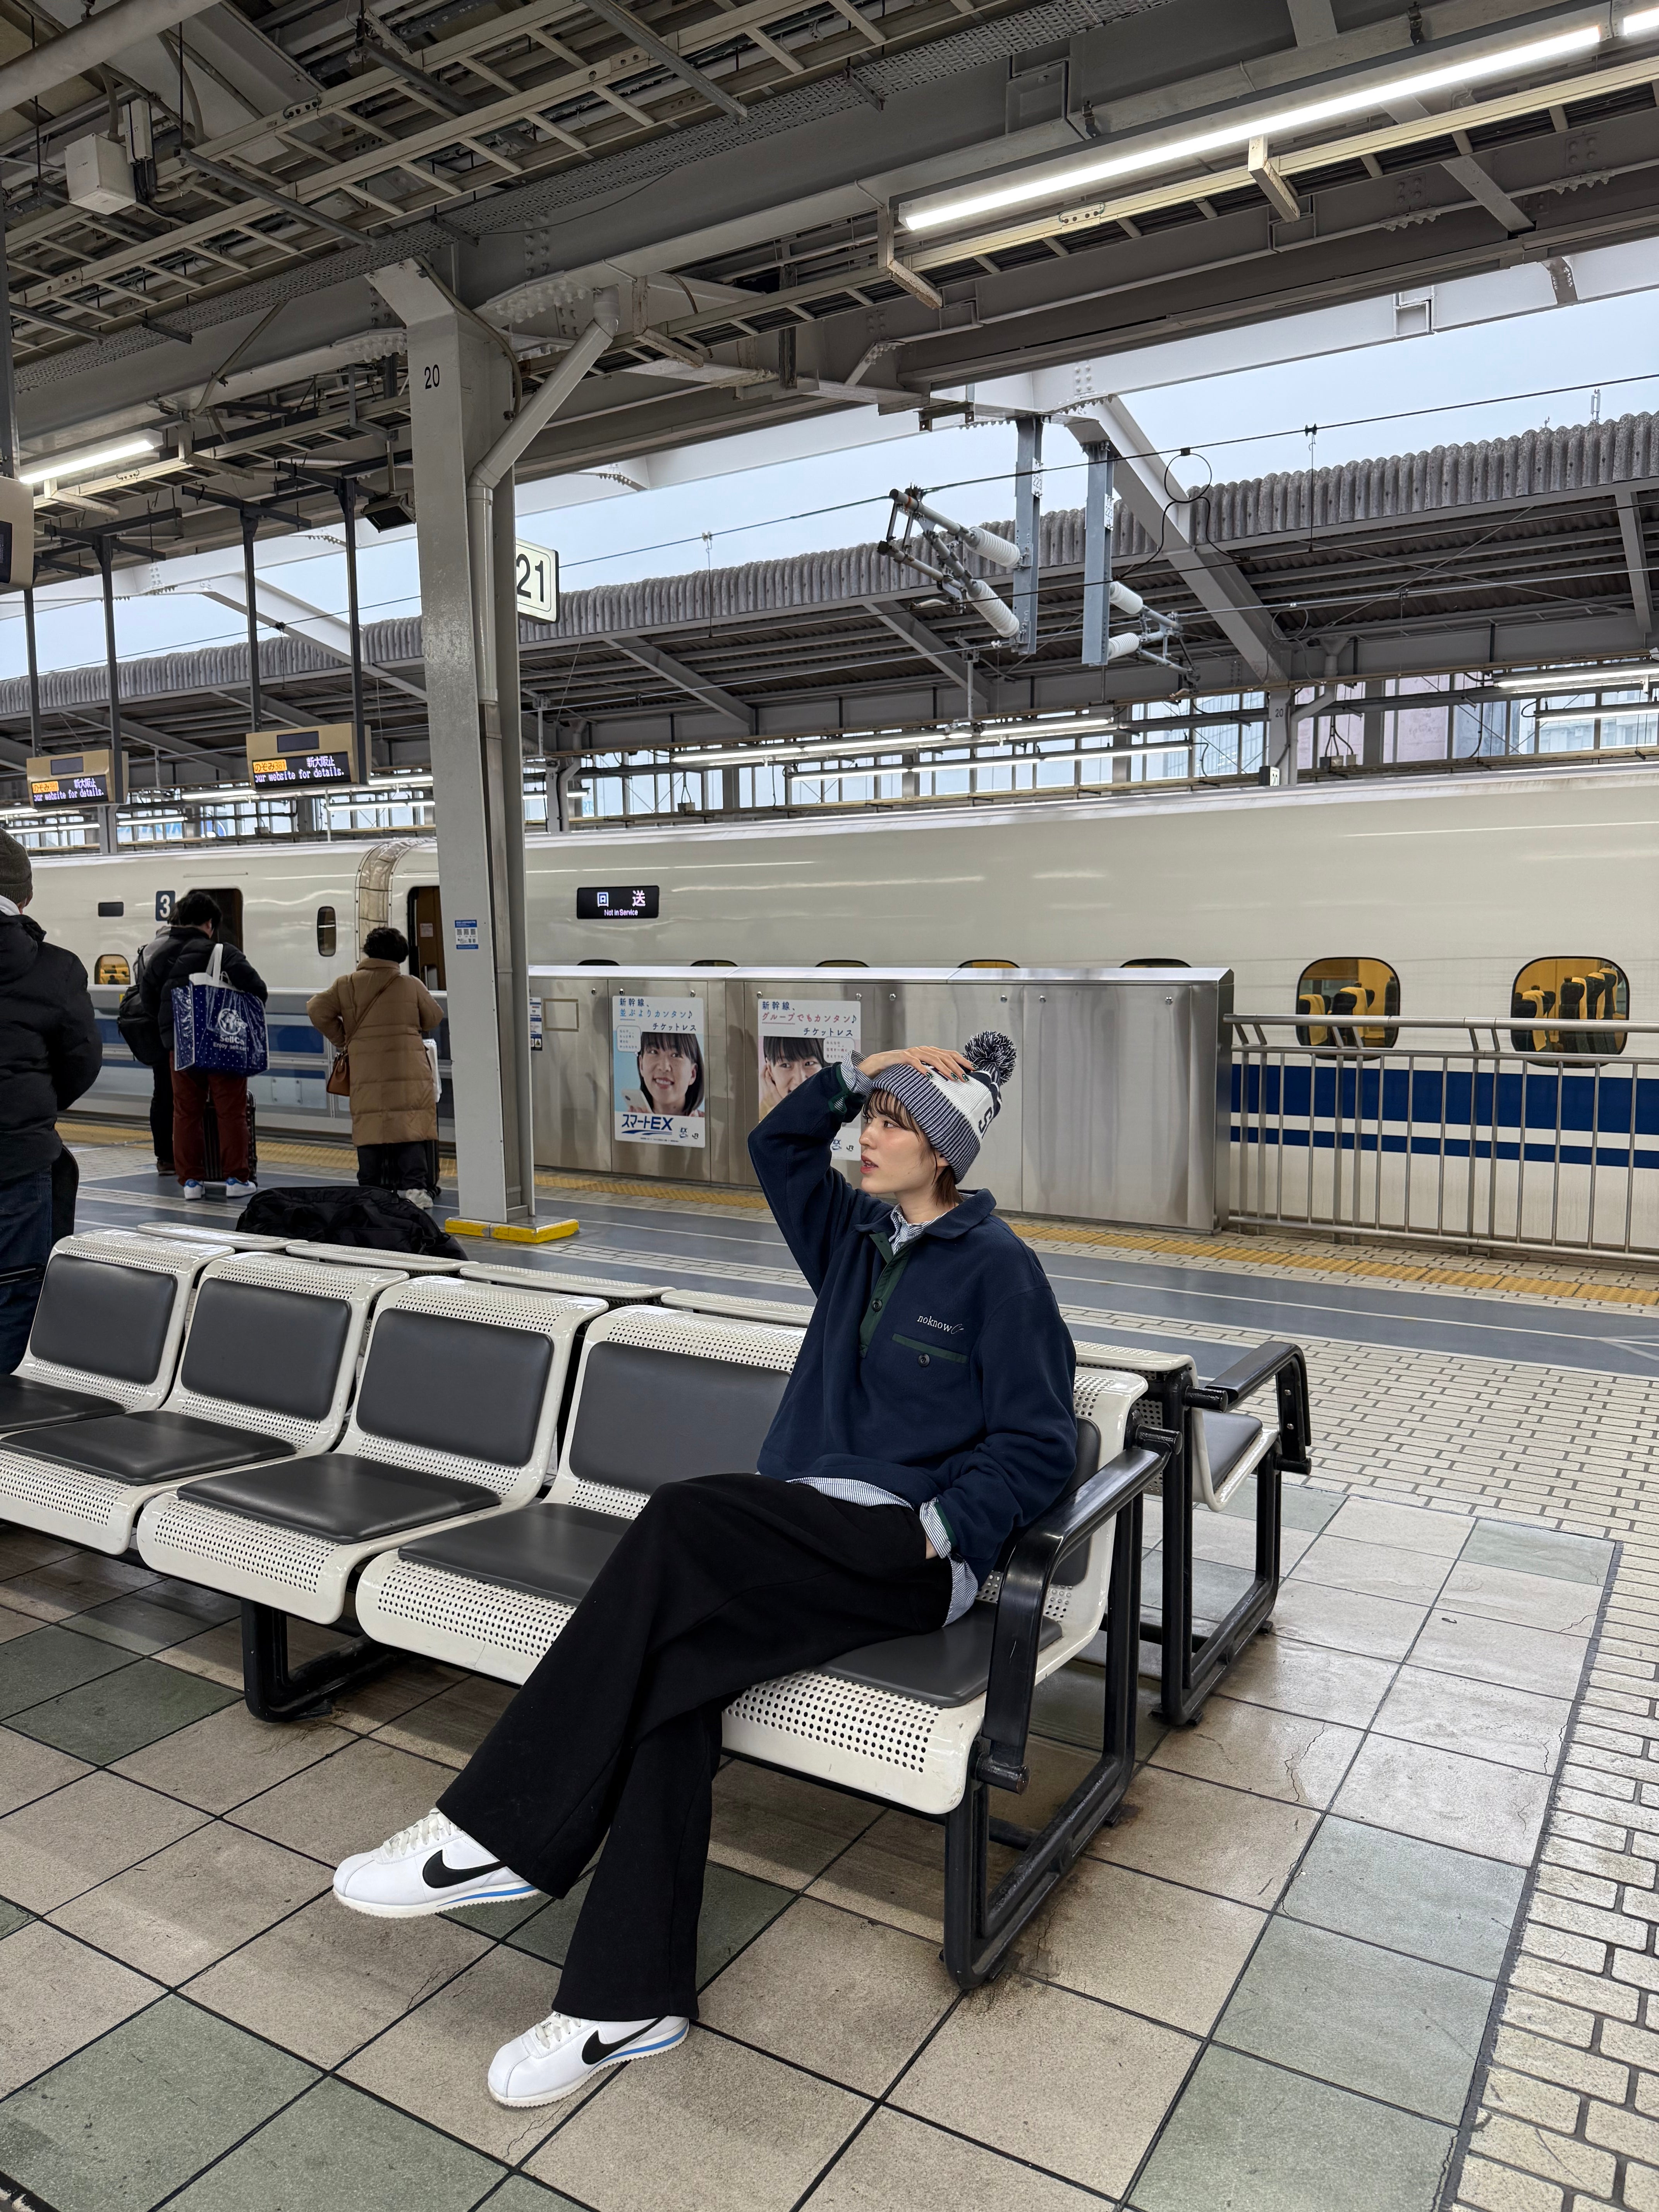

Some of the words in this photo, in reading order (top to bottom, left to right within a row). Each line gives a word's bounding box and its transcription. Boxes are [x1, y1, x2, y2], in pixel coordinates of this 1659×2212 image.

[424, 364, 440, 390] 20
[516, 553, 544, 603] 21
[1275, 708, 1284, 717] 20
[268, 771, 296, 781] website
[298, 769, 311, 780] for
[313, 766, 344, 778] details.
[68, 789, 78, 799] for
[160, 894, 170, 918] 3
[597, 890, 646, 907] 回送
[653, 1023, 696, 1031] チケットレス
[804, 1027, 853, 1037] チケットレス
[213, 1041, 228, 1050] Enjoy
[622, 1114, 674, 1131] スマートEX
[917, 1316, 953, 1332] noknow
